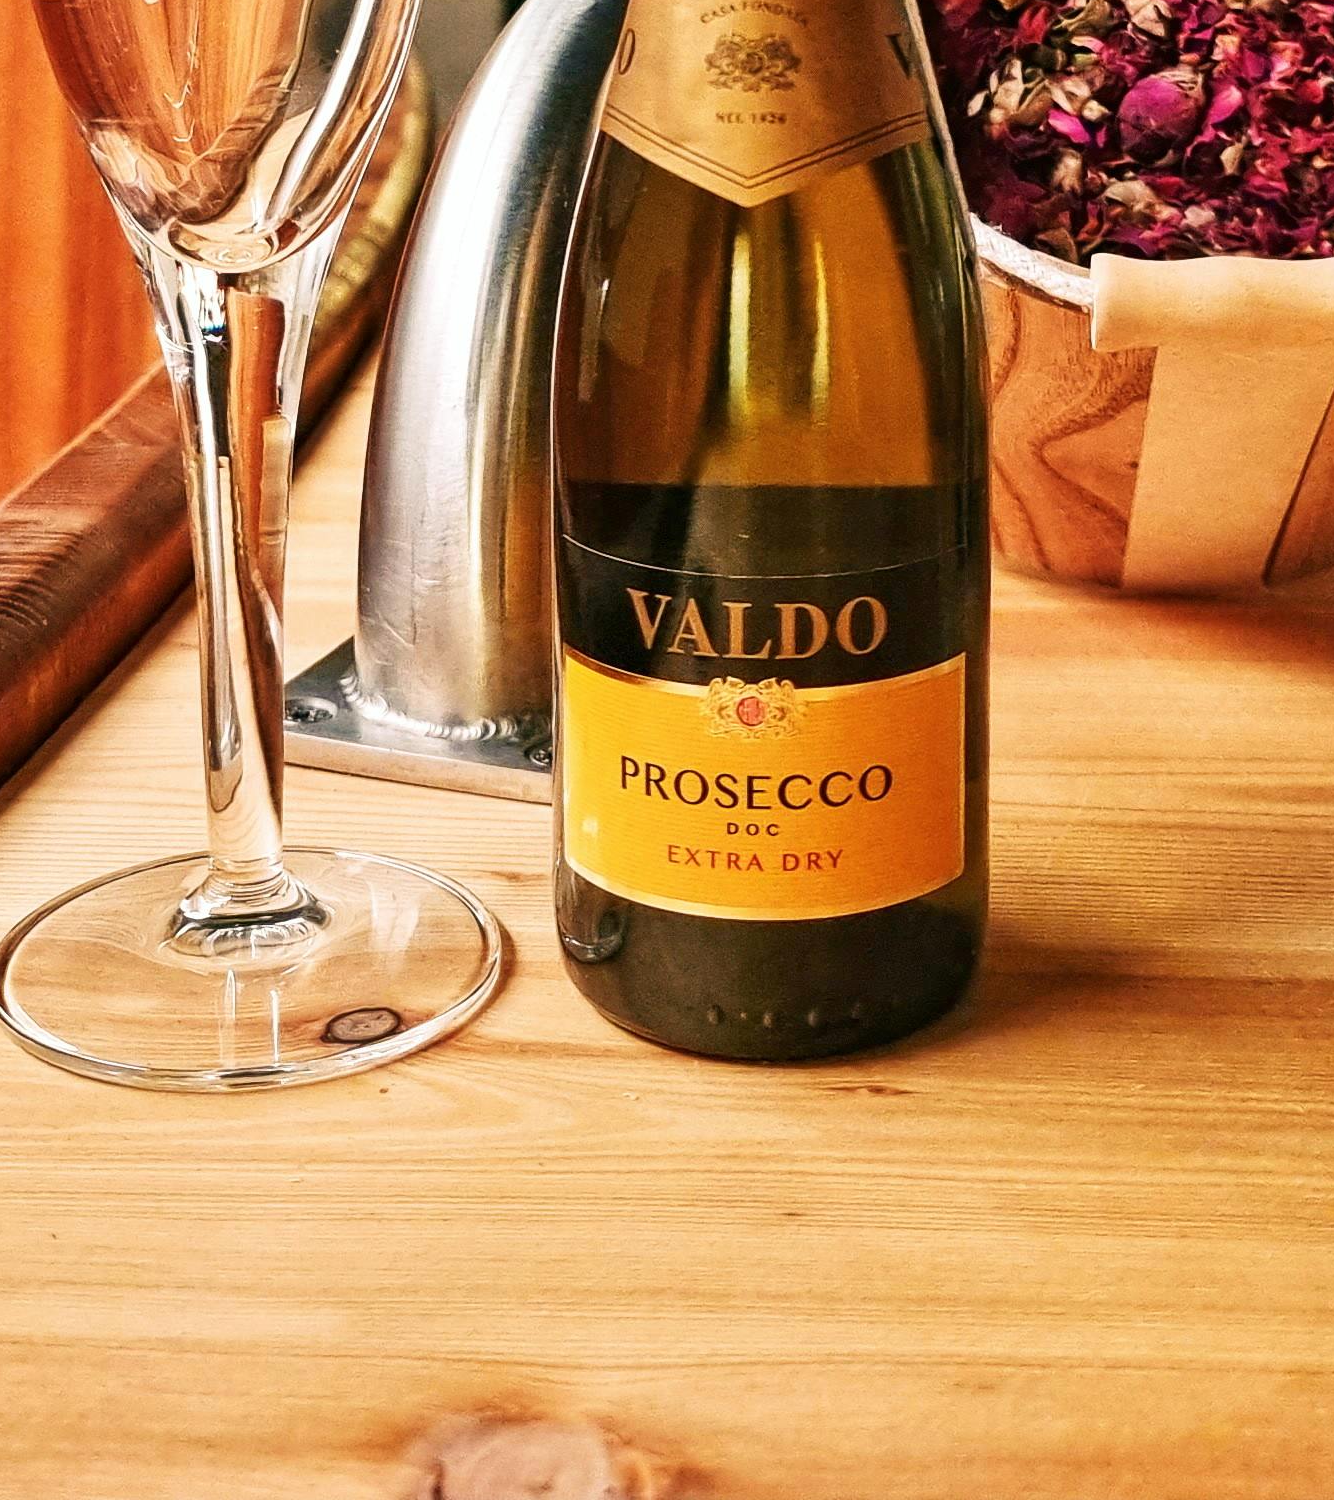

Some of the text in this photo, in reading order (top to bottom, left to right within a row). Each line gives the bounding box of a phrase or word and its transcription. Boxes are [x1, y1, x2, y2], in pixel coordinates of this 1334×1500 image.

[626, 587, 889, 660] VALDO
[620, 754, 894, 811] PROSECCO
[726, 822, 781, 837] DOC
[667, 843, 844, 873] EXTRA DRY
